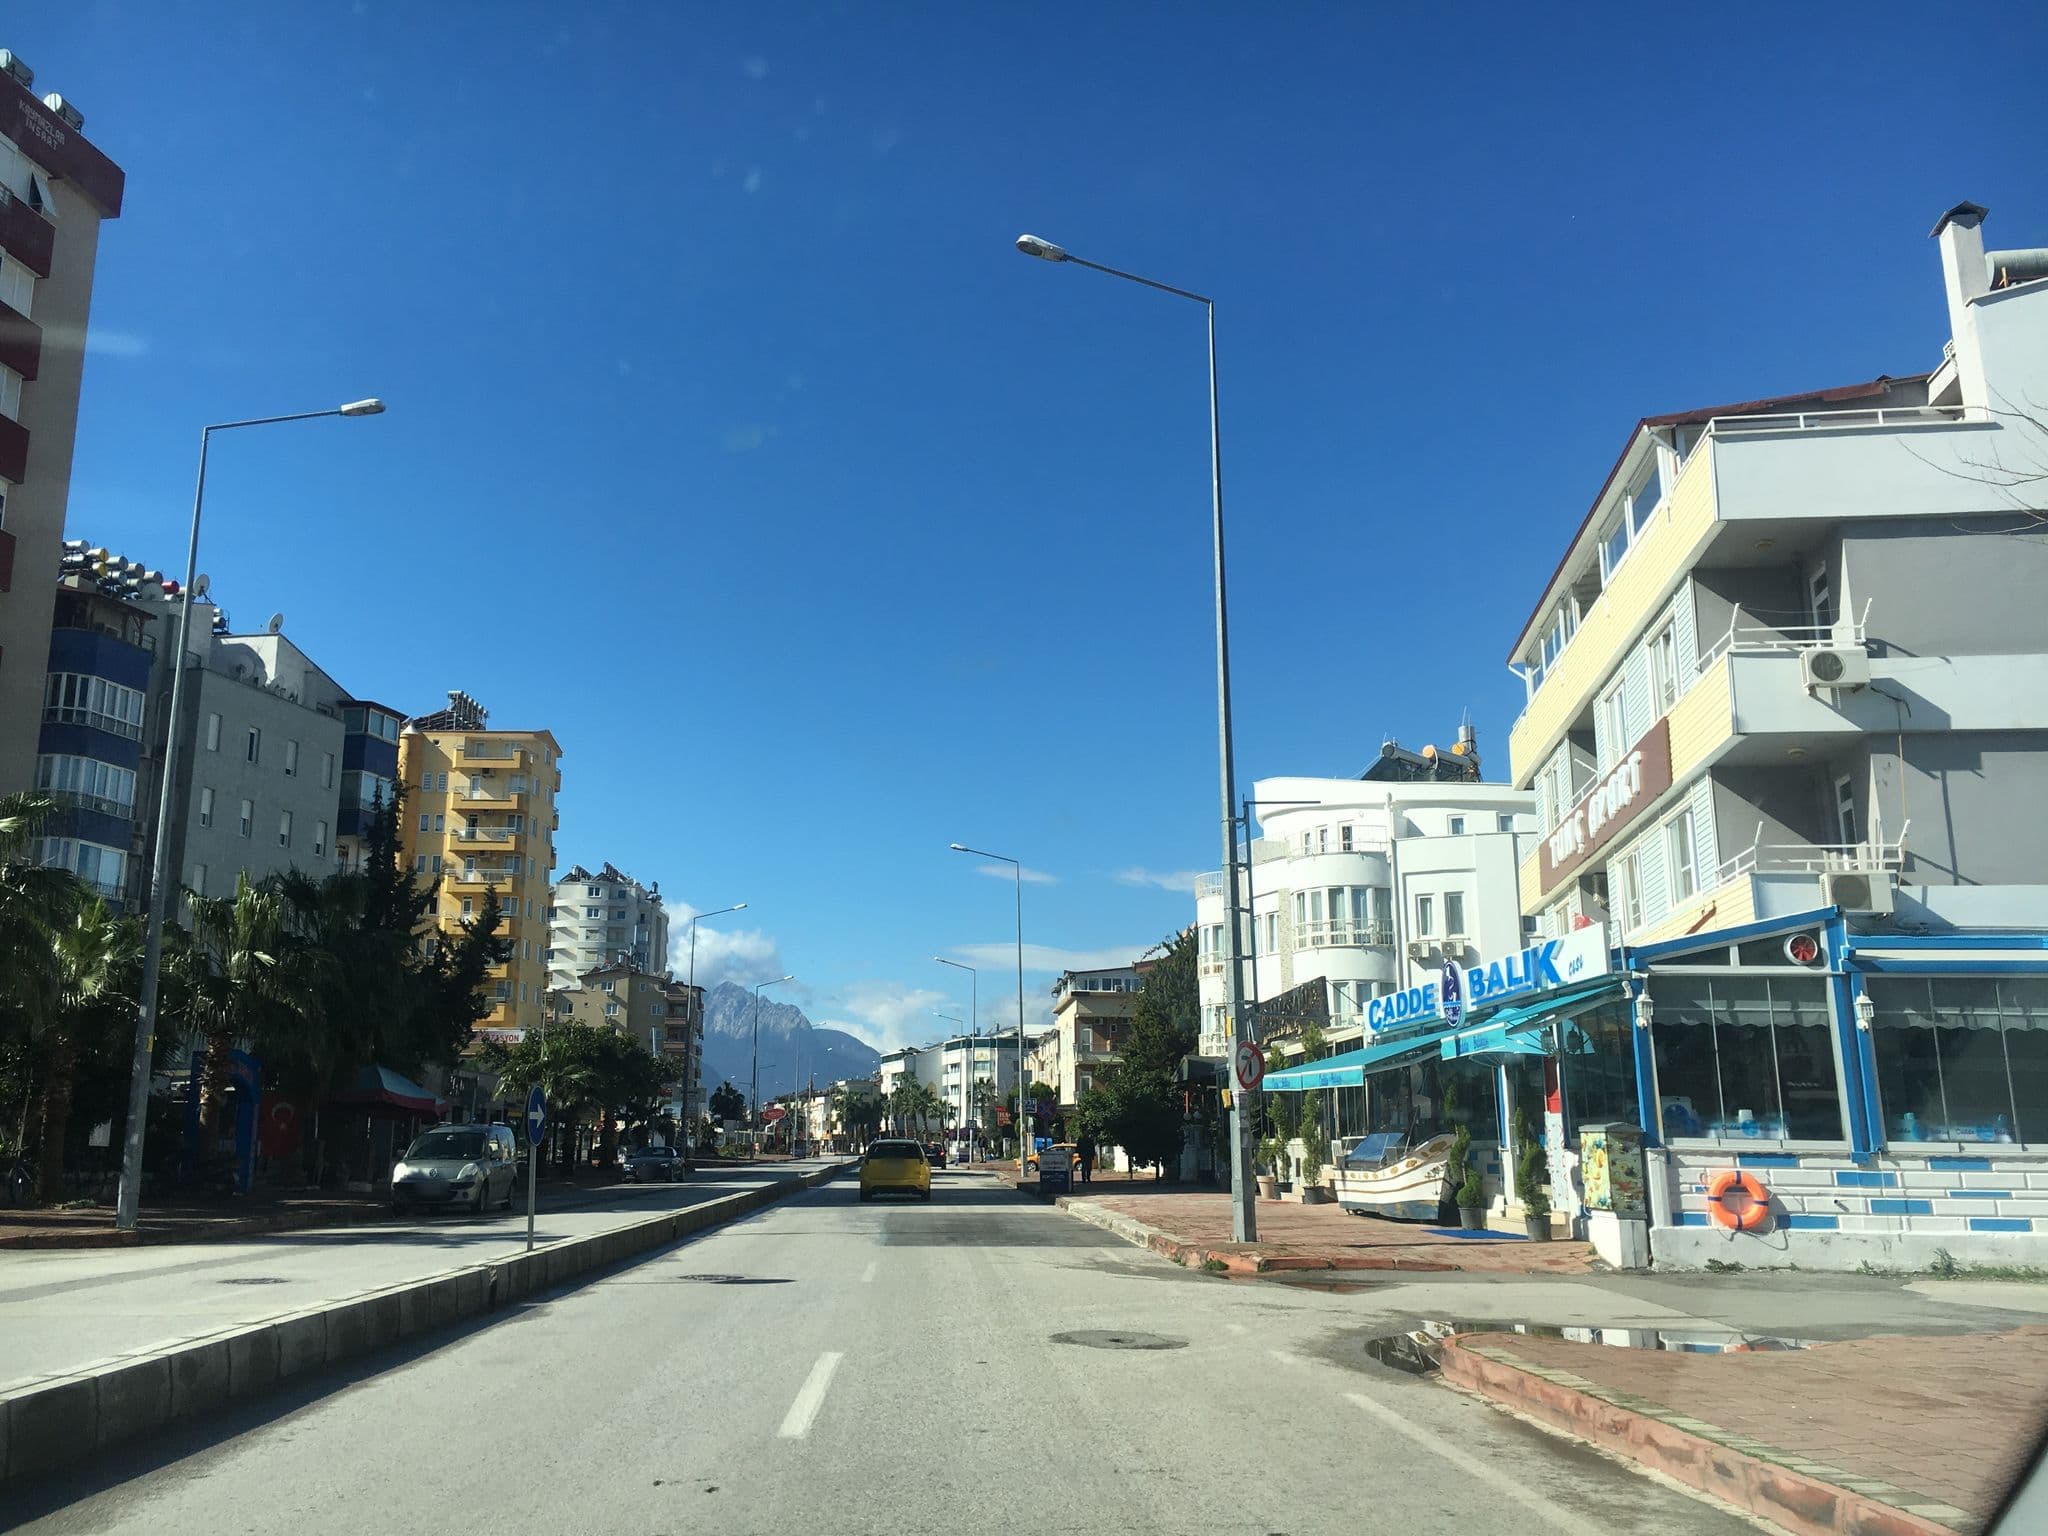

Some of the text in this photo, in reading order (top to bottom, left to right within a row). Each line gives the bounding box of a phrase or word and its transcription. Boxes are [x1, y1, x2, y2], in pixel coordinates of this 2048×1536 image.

[1588, 750, 1642, 838] APART
[1369, 983, 1436, 1031] CADDE
[1467, 939, 1563, 999] BALIK
